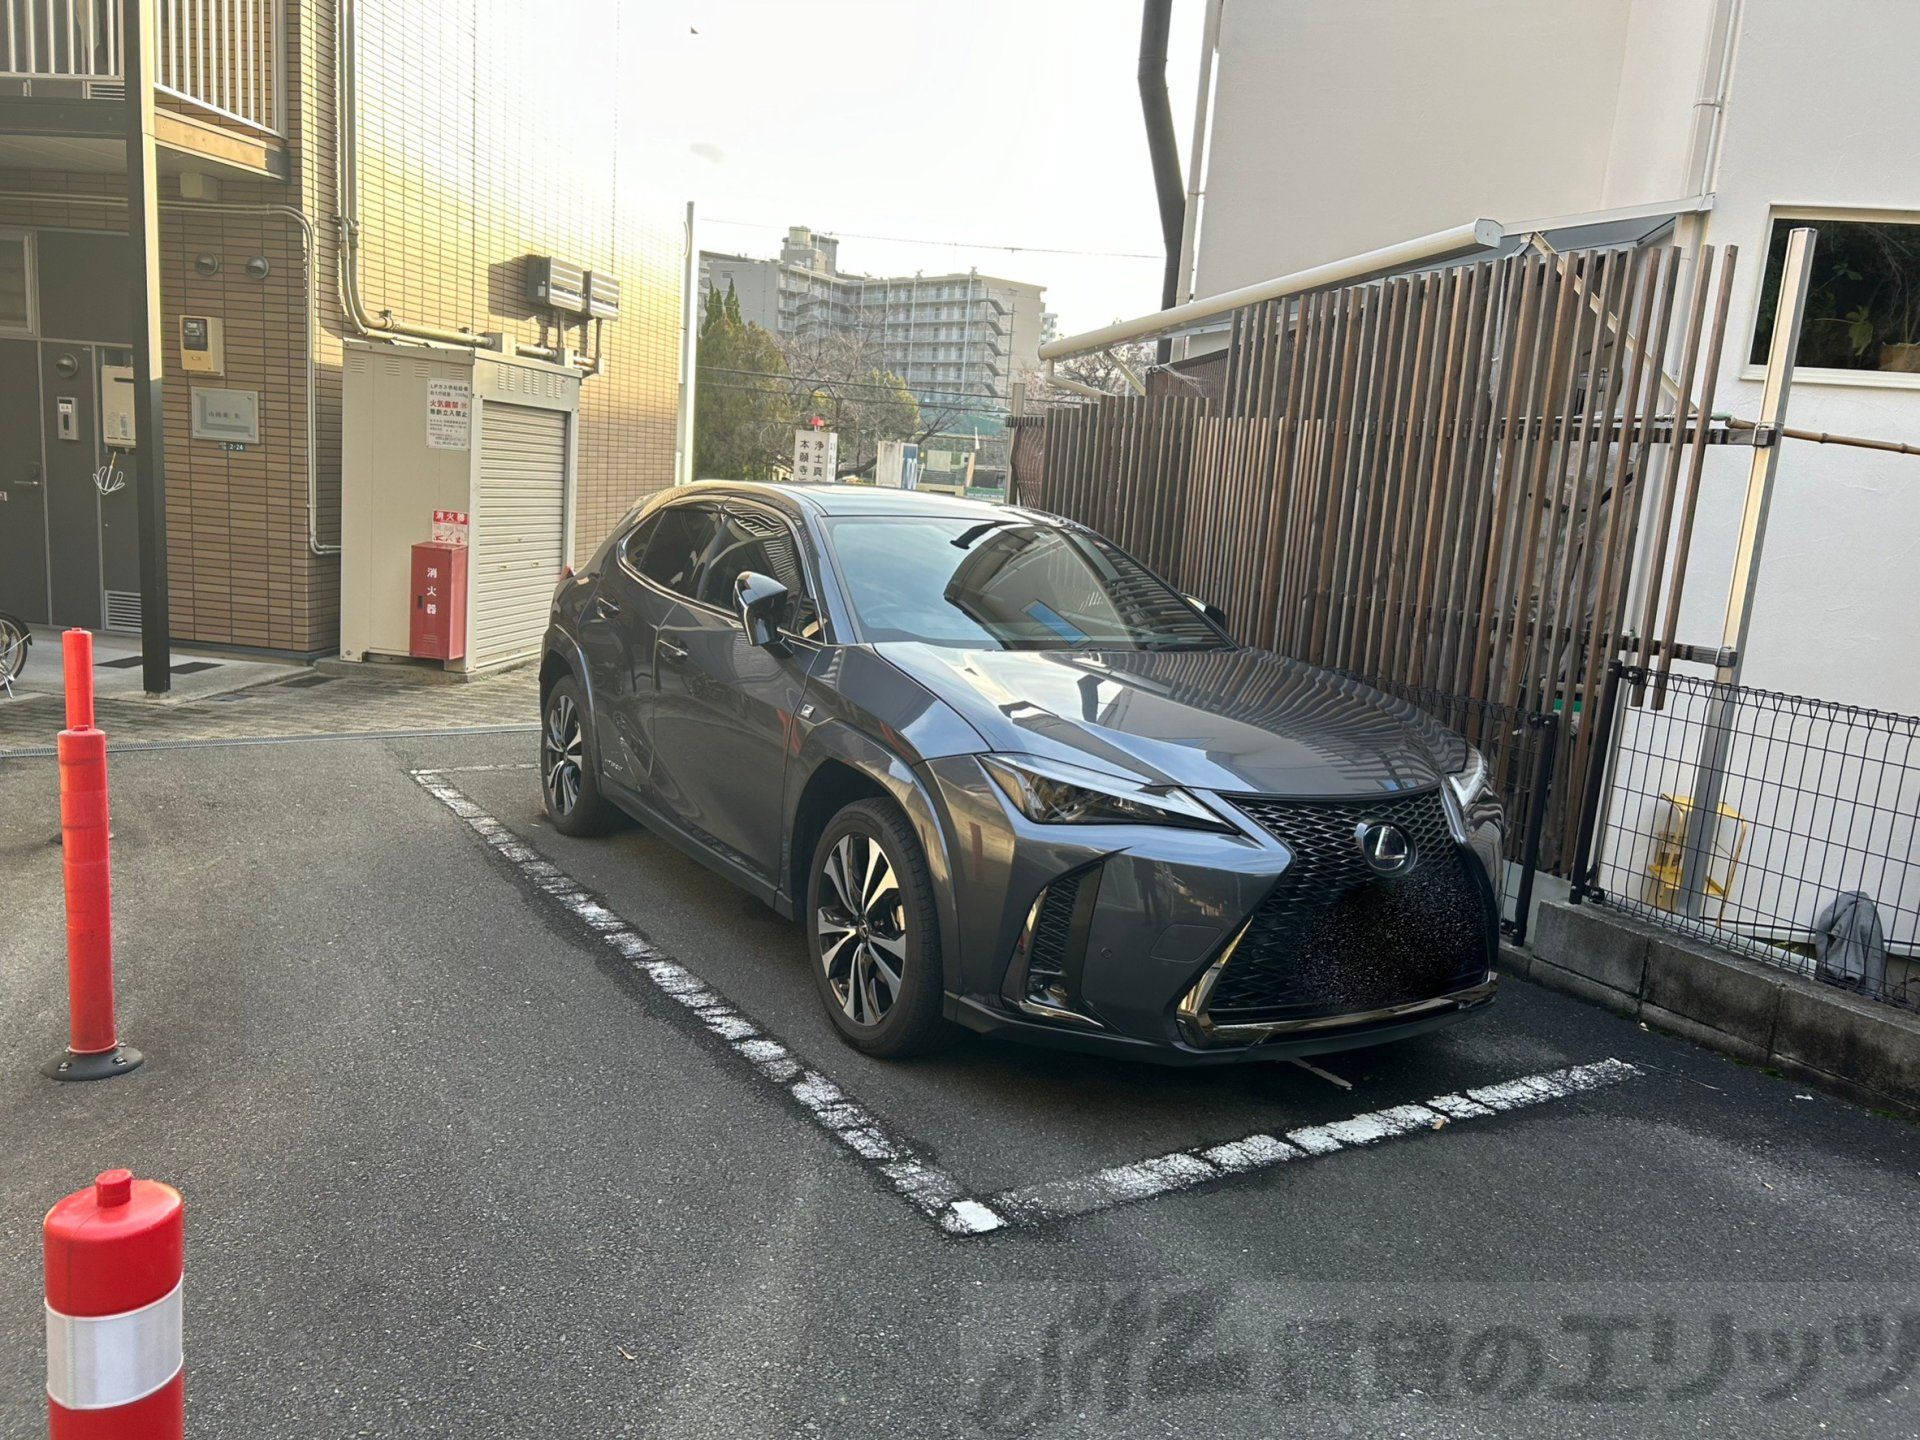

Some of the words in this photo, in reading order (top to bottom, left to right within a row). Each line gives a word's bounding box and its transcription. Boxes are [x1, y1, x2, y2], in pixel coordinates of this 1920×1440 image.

[799, 440, 810, 480] 本願寺
[814, 440, 824, 480] 浄土真
[427, 567, 437, 614] 消火器
